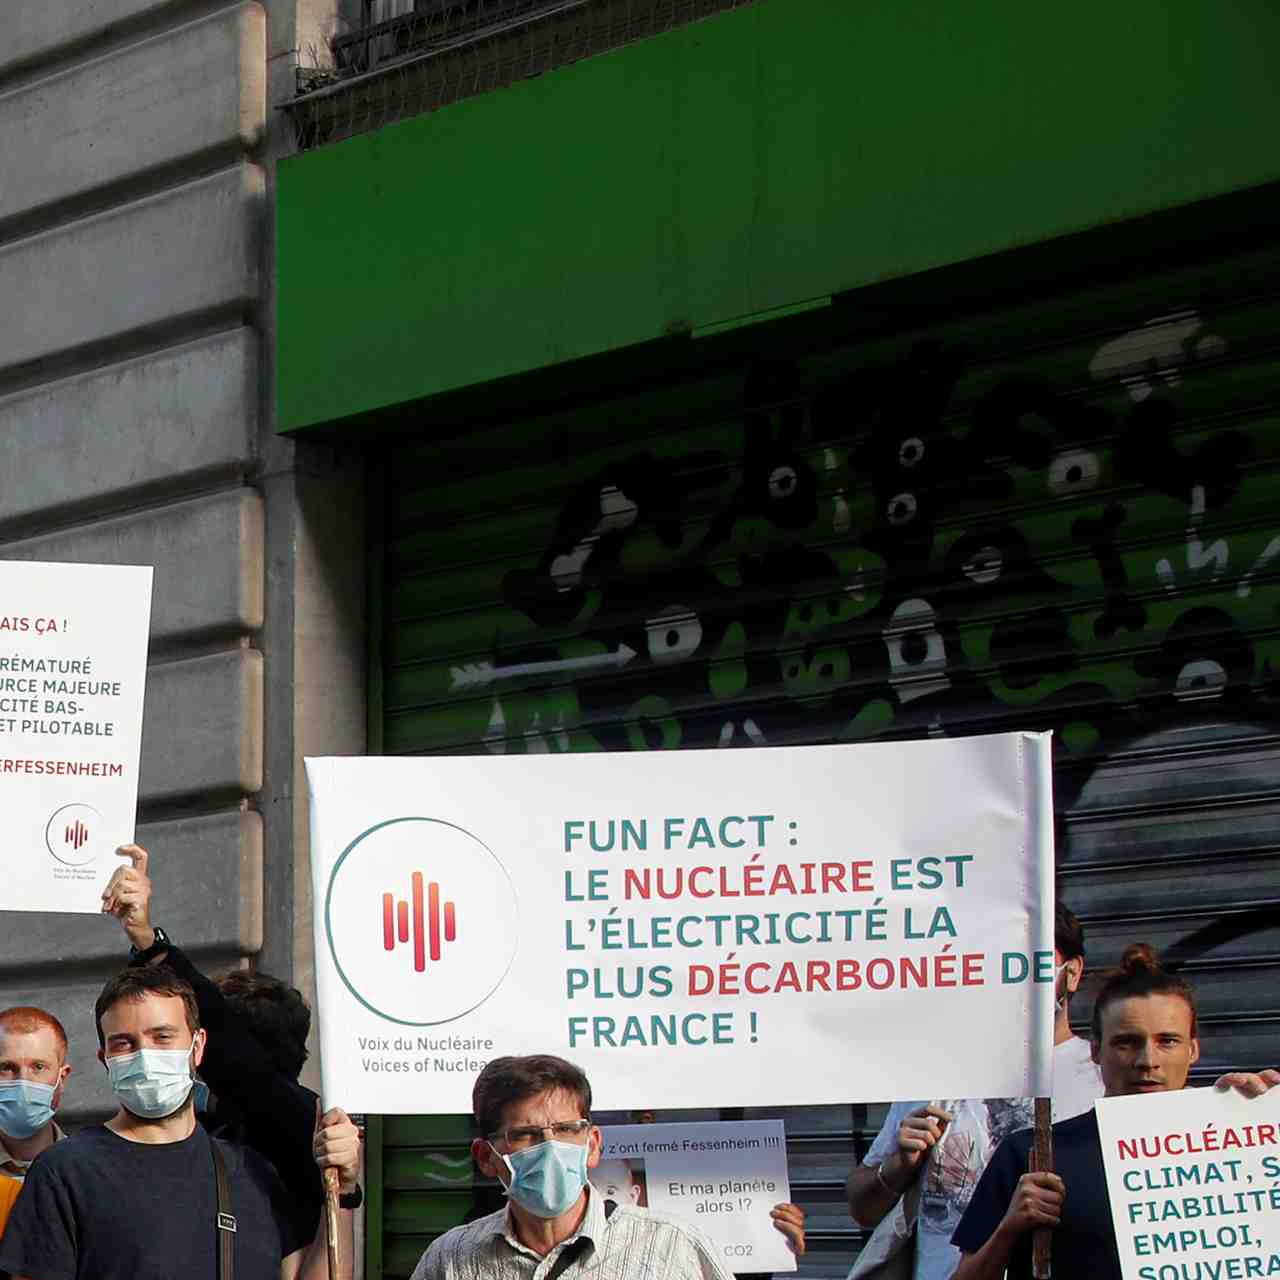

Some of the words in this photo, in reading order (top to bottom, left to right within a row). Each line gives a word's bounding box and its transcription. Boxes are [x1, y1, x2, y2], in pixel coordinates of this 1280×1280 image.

[34, 618, 58, 636] ÇA
[62, 619, 69, 633] !
[42, 679, 121, 696] MAJEURE
[44, 700, 85, 715] BAS-
[21, 719, 114, 737] PILOTABLE
[563, 819, 649, 853] FUN
[662, 815, 775, 850] FACT
[788, 820, 800, 846] :
[564, 869, 610, 903] LE
[623, 853, 875, 901] NUCLÉAIRE
[889, 853, 975, 890] EST
[564, 896, 888, 952] L’ÉLECTRICITÉ
[903, 906, 958, 939] LA
[565, 965, 674, 1000] PLUS
[687, 944, 986, 996] DÉCARBONÉE
[1002, 950, 1054, 984] DE
[567, 1012, 736, 1049] FRANCE
[748, 1011, 760, 1043] !
[358, 1036, 390, 1050] Voix
[394, 1036, 413, 1050] du
[417, 1035, 494, 1050] Nucléaire
[362, 1058, 410, 1072] Voices
[414, 1057, 430, 1072] of
[641, 1139, 678, 1153] fermé
[683, 1137, 760, 1151] Fessenheim
[1117, 1122, 1280, 1161] NUCLÉAIR
[1122, 1159, 1254, 1192] CLIMAT,
[669, 1182, 685, 1196] Et
[690, 1183, 714, 1195] ma
[719, 1179, 776, 1197] planète
[696, 1198, 734, 1214] alors
[1133, 1224, 1263, 1256] EMPLOI,
[723, 1244, 753, 1257] CO2
